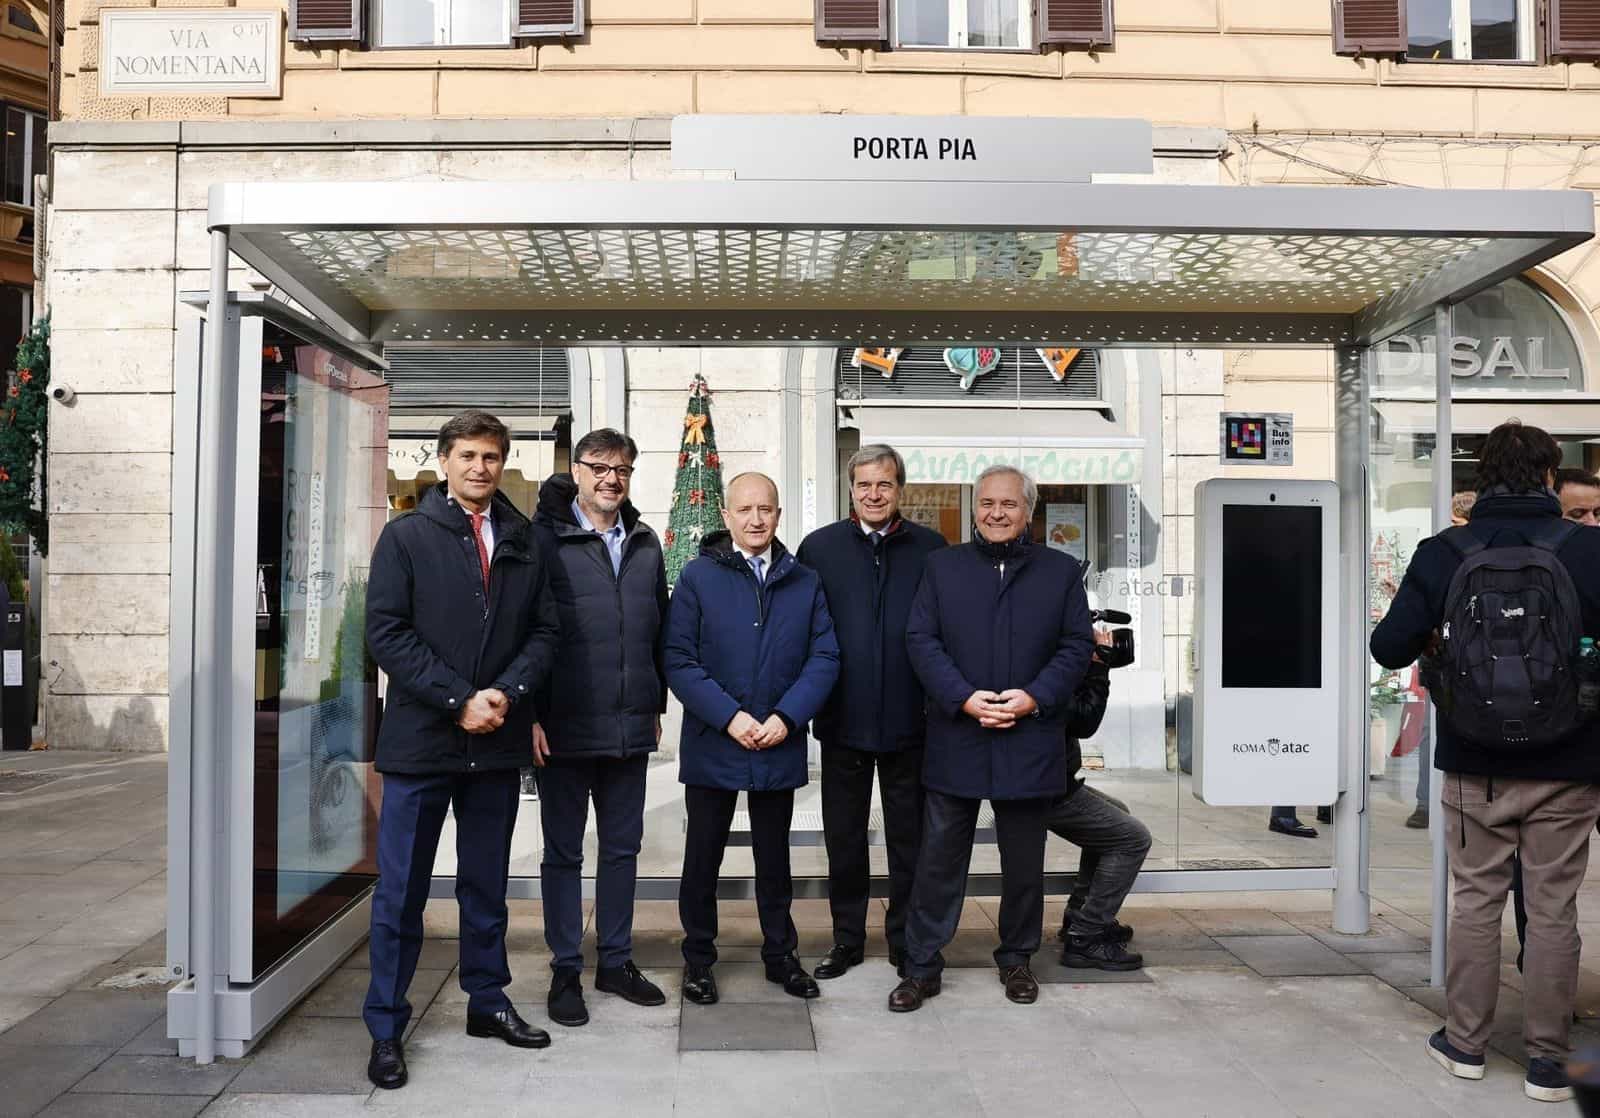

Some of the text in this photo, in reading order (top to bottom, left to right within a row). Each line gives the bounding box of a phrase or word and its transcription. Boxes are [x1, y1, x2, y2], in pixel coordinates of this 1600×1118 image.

[169, 29, 209, 49] VIA
[233, 24, 244, 38] Q
[116, 56, 262, 75] NOMENTANA
[853, 136, 977, 161] PORTA PIA
[1272, 429, 1290, 437] Bus
[1272, 438, 1290, 446] info
[1119, 578, 1168, 596] atac
[1232, 742, 1310, 754] ROMA atac
